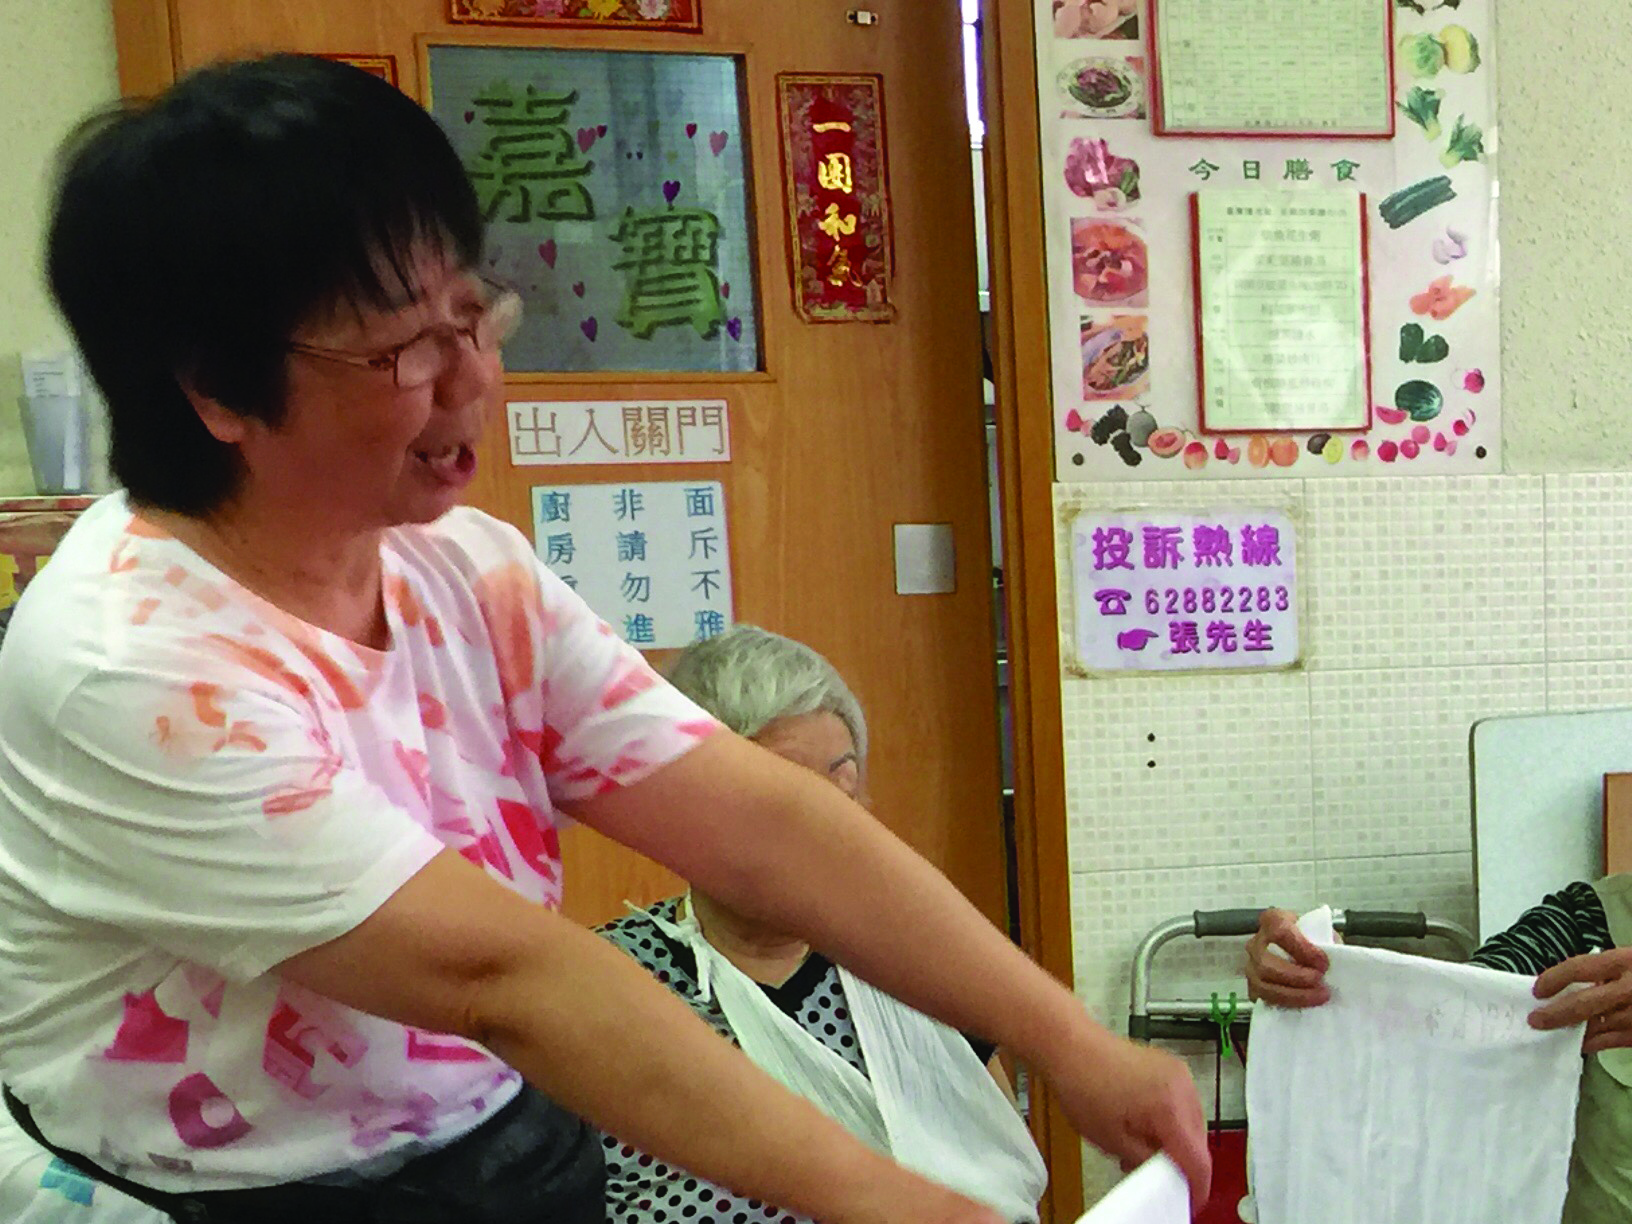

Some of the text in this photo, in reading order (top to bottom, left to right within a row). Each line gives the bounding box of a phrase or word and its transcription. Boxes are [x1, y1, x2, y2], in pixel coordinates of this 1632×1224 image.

[1189, 158, 1361, 181] 今日膳食
[514, 405, 726, 458] 出入關門
[612, 488, 656, 644] 非請勿進
[684, 485, 725, 642] 面斥不雅
[1092, 524, 1283, 570] 投訴熱線
[1144, 586, 1289, 615] 62882283
[1168, 618, 1274, 654] 張先生
